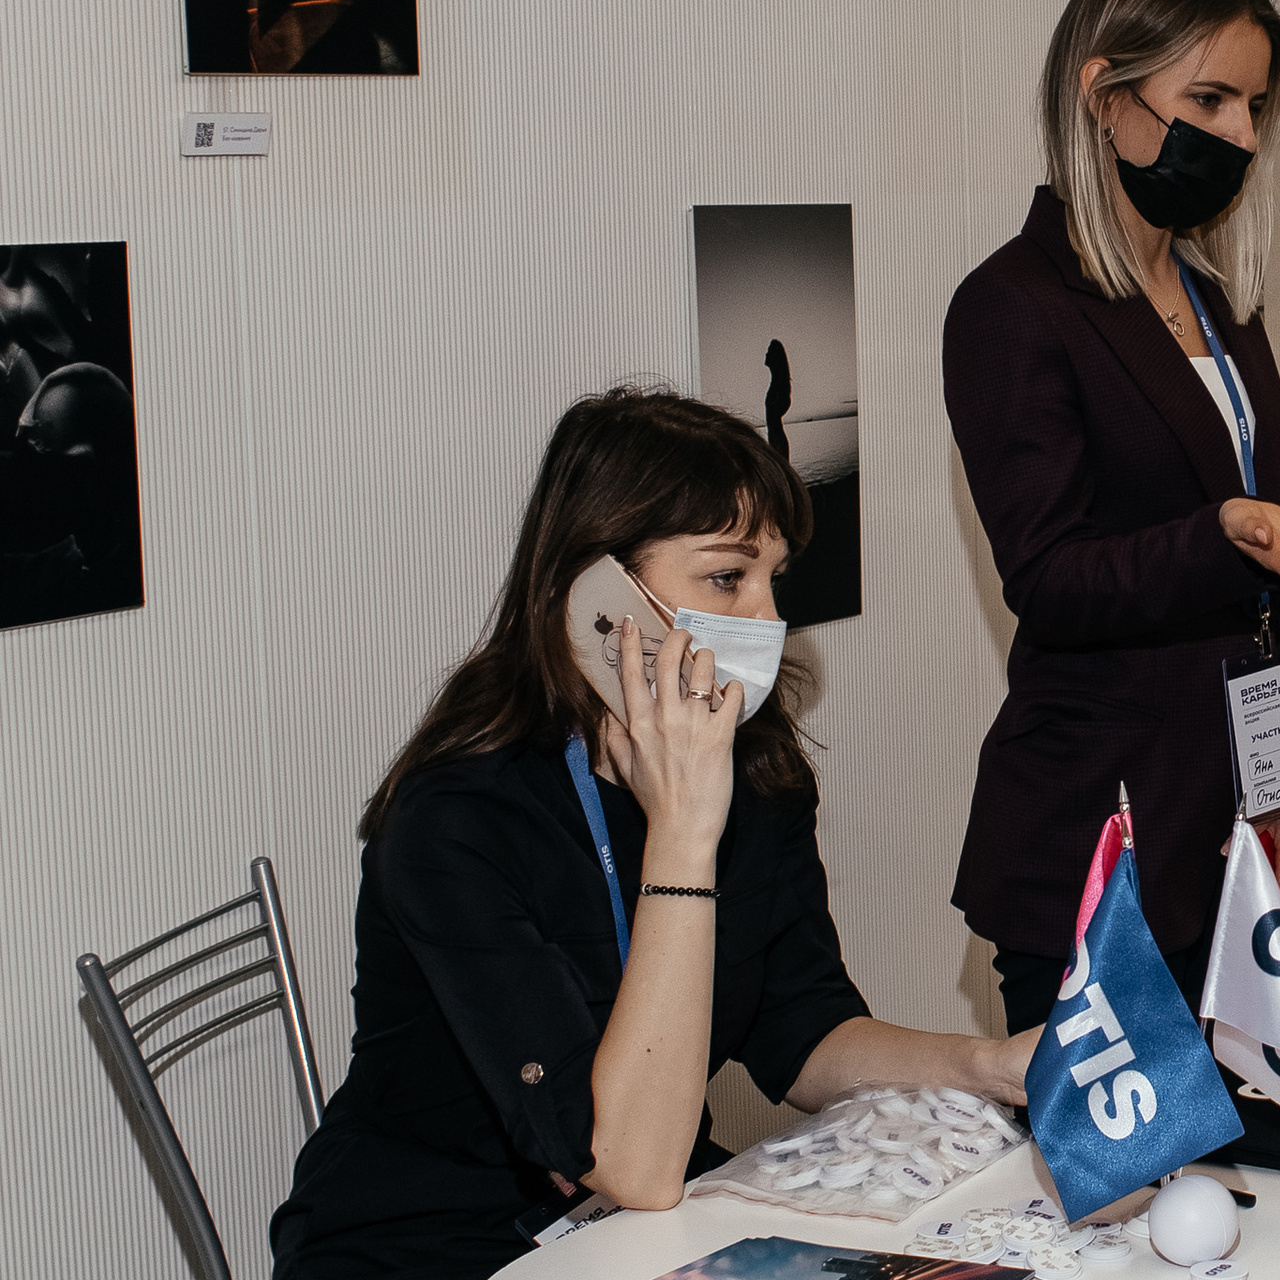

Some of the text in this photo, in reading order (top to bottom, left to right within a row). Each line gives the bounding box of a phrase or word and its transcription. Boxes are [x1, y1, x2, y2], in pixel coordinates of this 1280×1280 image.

[1200, 316, 1212, 337] OTIS
[1239, 417, 1248, 441] OTIS
[1241, 679, 1278, 697] ВРЕМЯ
[1244, 704, 1280, 719] всероссийская
[602, 845, 614, 873] OTIS
